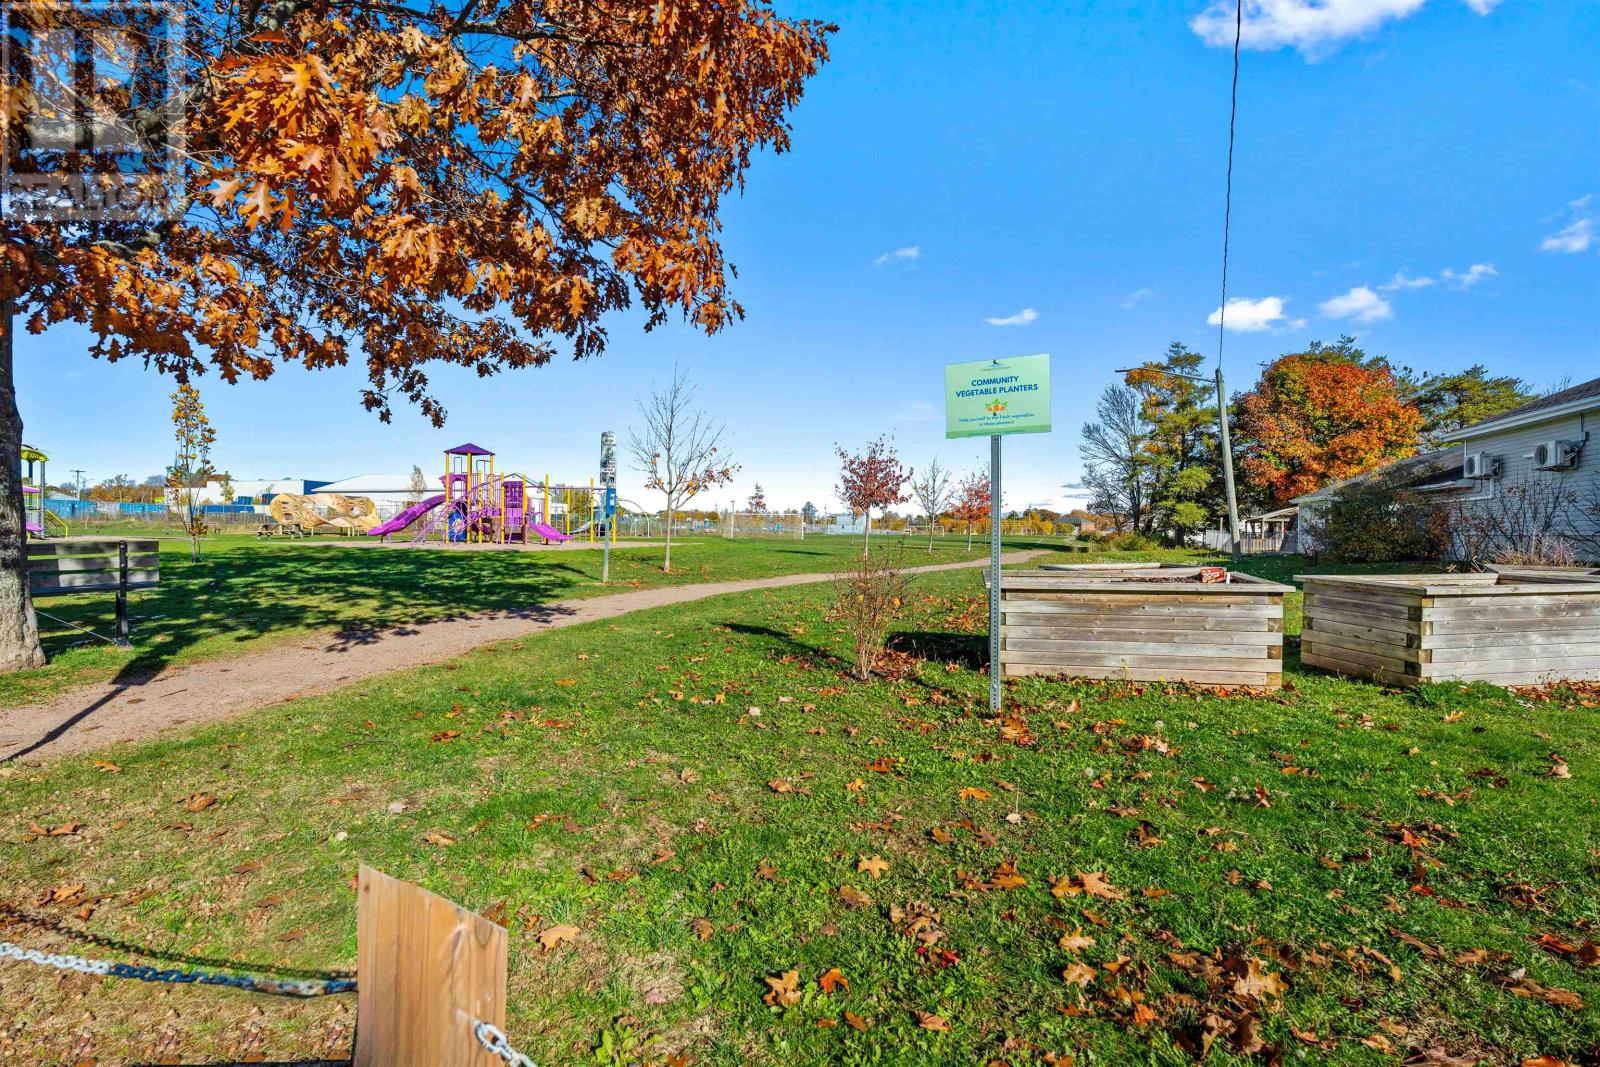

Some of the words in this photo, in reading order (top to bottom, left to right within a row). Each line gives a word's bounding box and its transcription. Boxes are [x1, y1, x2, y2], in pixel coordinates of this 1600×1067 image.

[971, 376, 1019, 386] COMMUNITY
[956, 387, 997, 397] VEGETABLE
[999, 384, 1038, 393] PLANTERS
